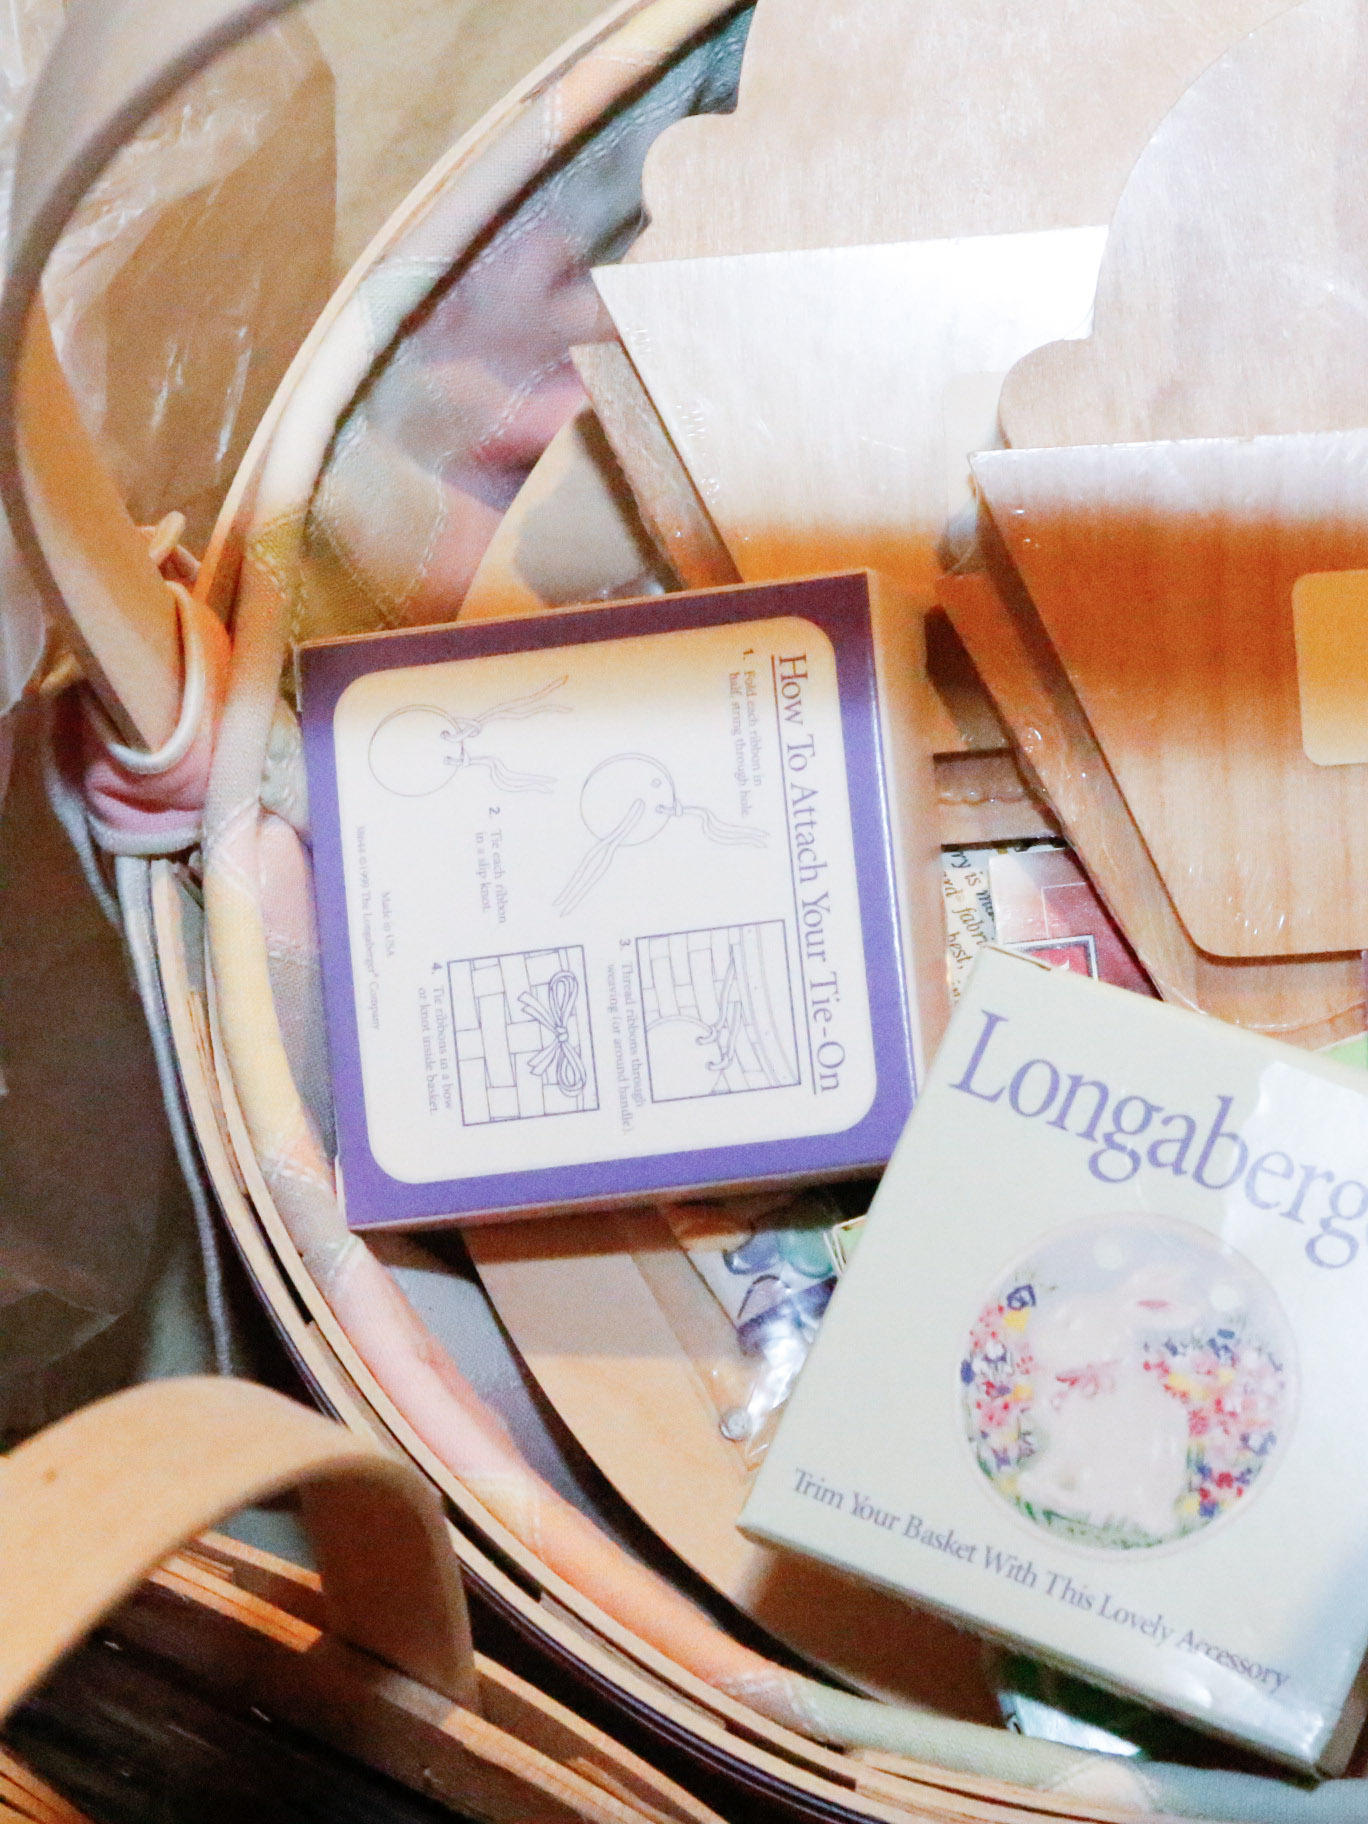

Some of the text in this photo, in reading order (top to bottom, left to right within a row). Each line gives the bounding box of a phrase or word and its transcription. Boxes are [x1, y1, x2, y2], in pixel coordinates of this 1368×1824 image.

[743, 669, 757, 696] Fold
[728, 700, 744, 735] string
[745, 699, 759, 727] each
[731, 737, 750, 787] through
[749, 730, 764, 771] ribbon
[475, 831, 486, 844] in
[489, 829, 503, 849] Tie
[474, 857, 490, 879] slip
[492, 851, 505, 879] each
[779, 653, 846, 1091] How To Attach Your Tie-On
[379, 890, 393, 919] Made
[494, 883, 510, 923] ribbon
[384, 933, 396, 958] USA
[951, 907, 988, 946] fabri
[430, 961, 442, 974] 4.
[620, 961, 637, 1005] Thread
[366, 980, 383, 1031] Company
[432, 985, 445, 1004] Tie
[434, 1007, 450, 1054] ribbons
[603, 963, 634, 1136] weaving (or around handle).
[625, 1007, 642, 1055] ribbons
[418, 986, 440, 1115] or knot inside basket.
[442, 1083, 455, 1109] bow
[628, 1058, 647, 1107] through
[792, 1468, 1287, 1698] Trim Your Basket With This Lovely Accessory
